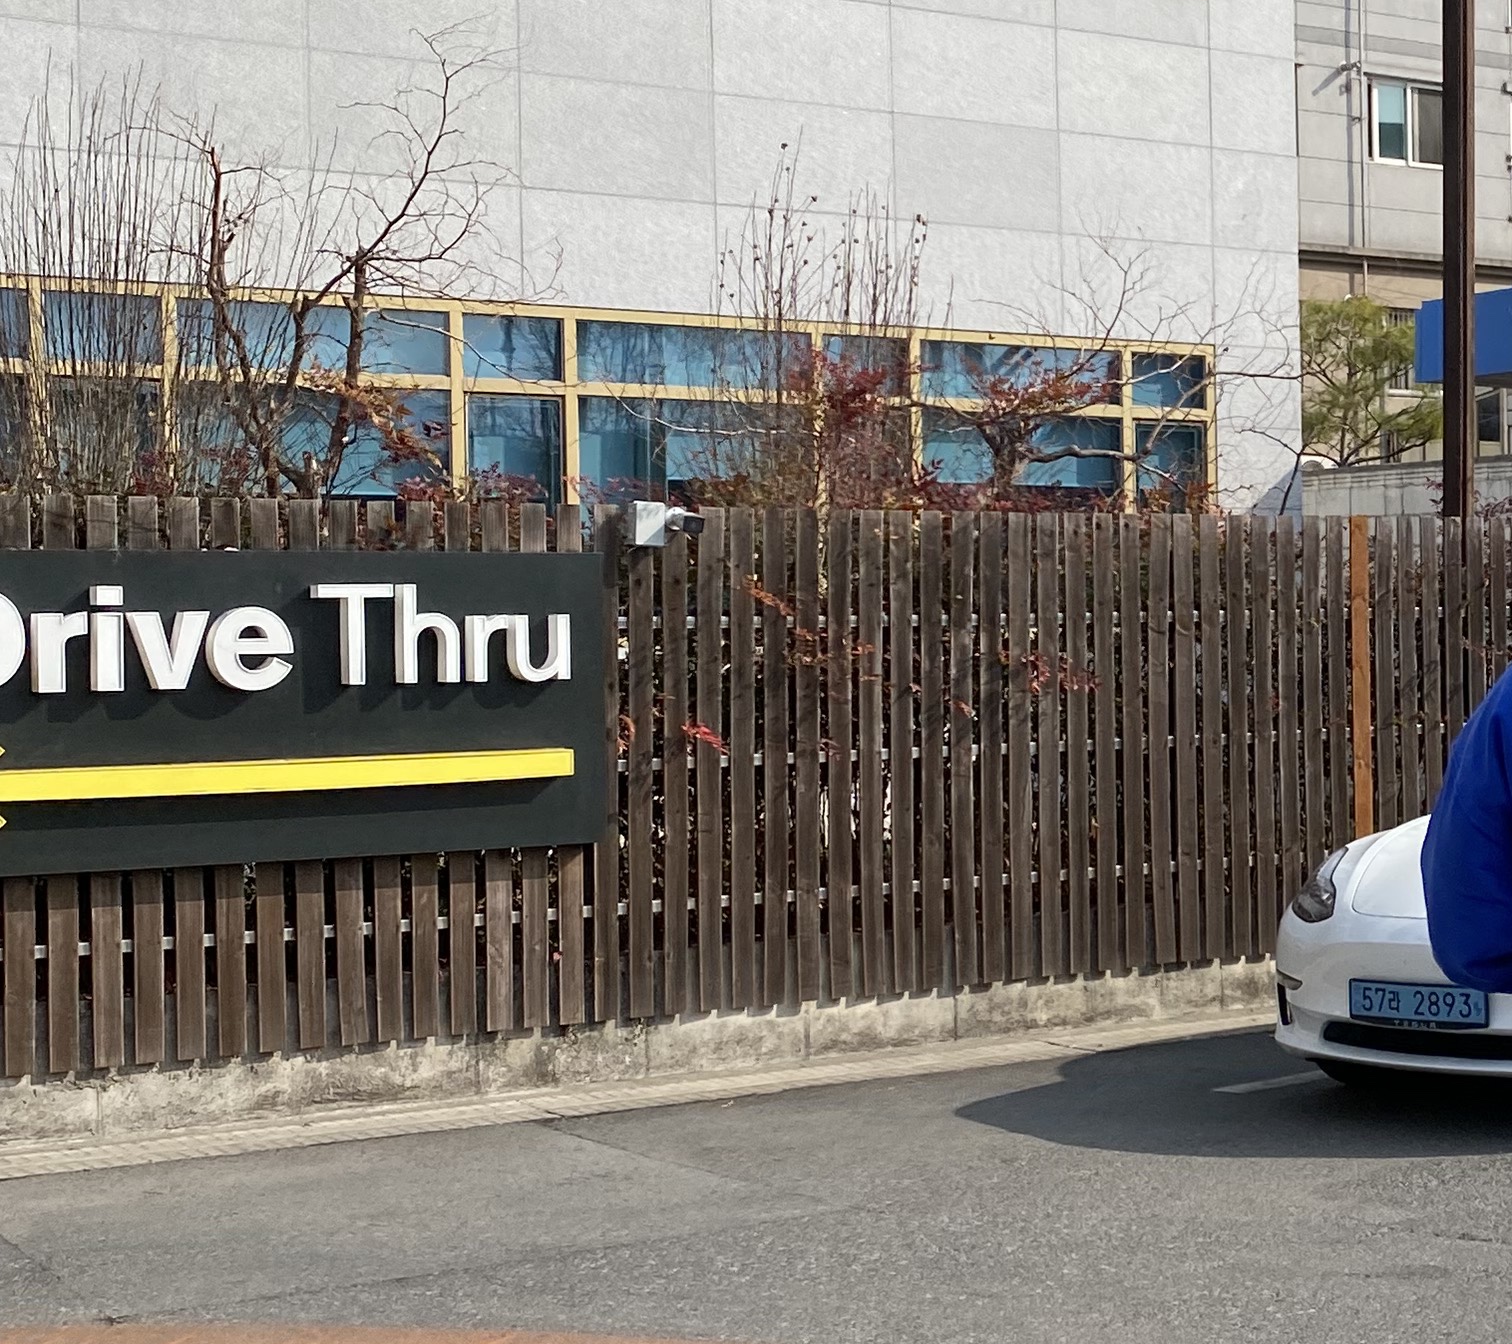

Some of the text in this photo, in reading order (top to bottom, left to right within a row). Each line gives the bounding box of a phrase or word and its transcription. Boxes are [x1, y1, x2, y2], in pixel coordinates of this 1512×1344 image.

[310, 583, 572, 685] Thru
[1362, 987, 1473, 1019] 57라 2893
